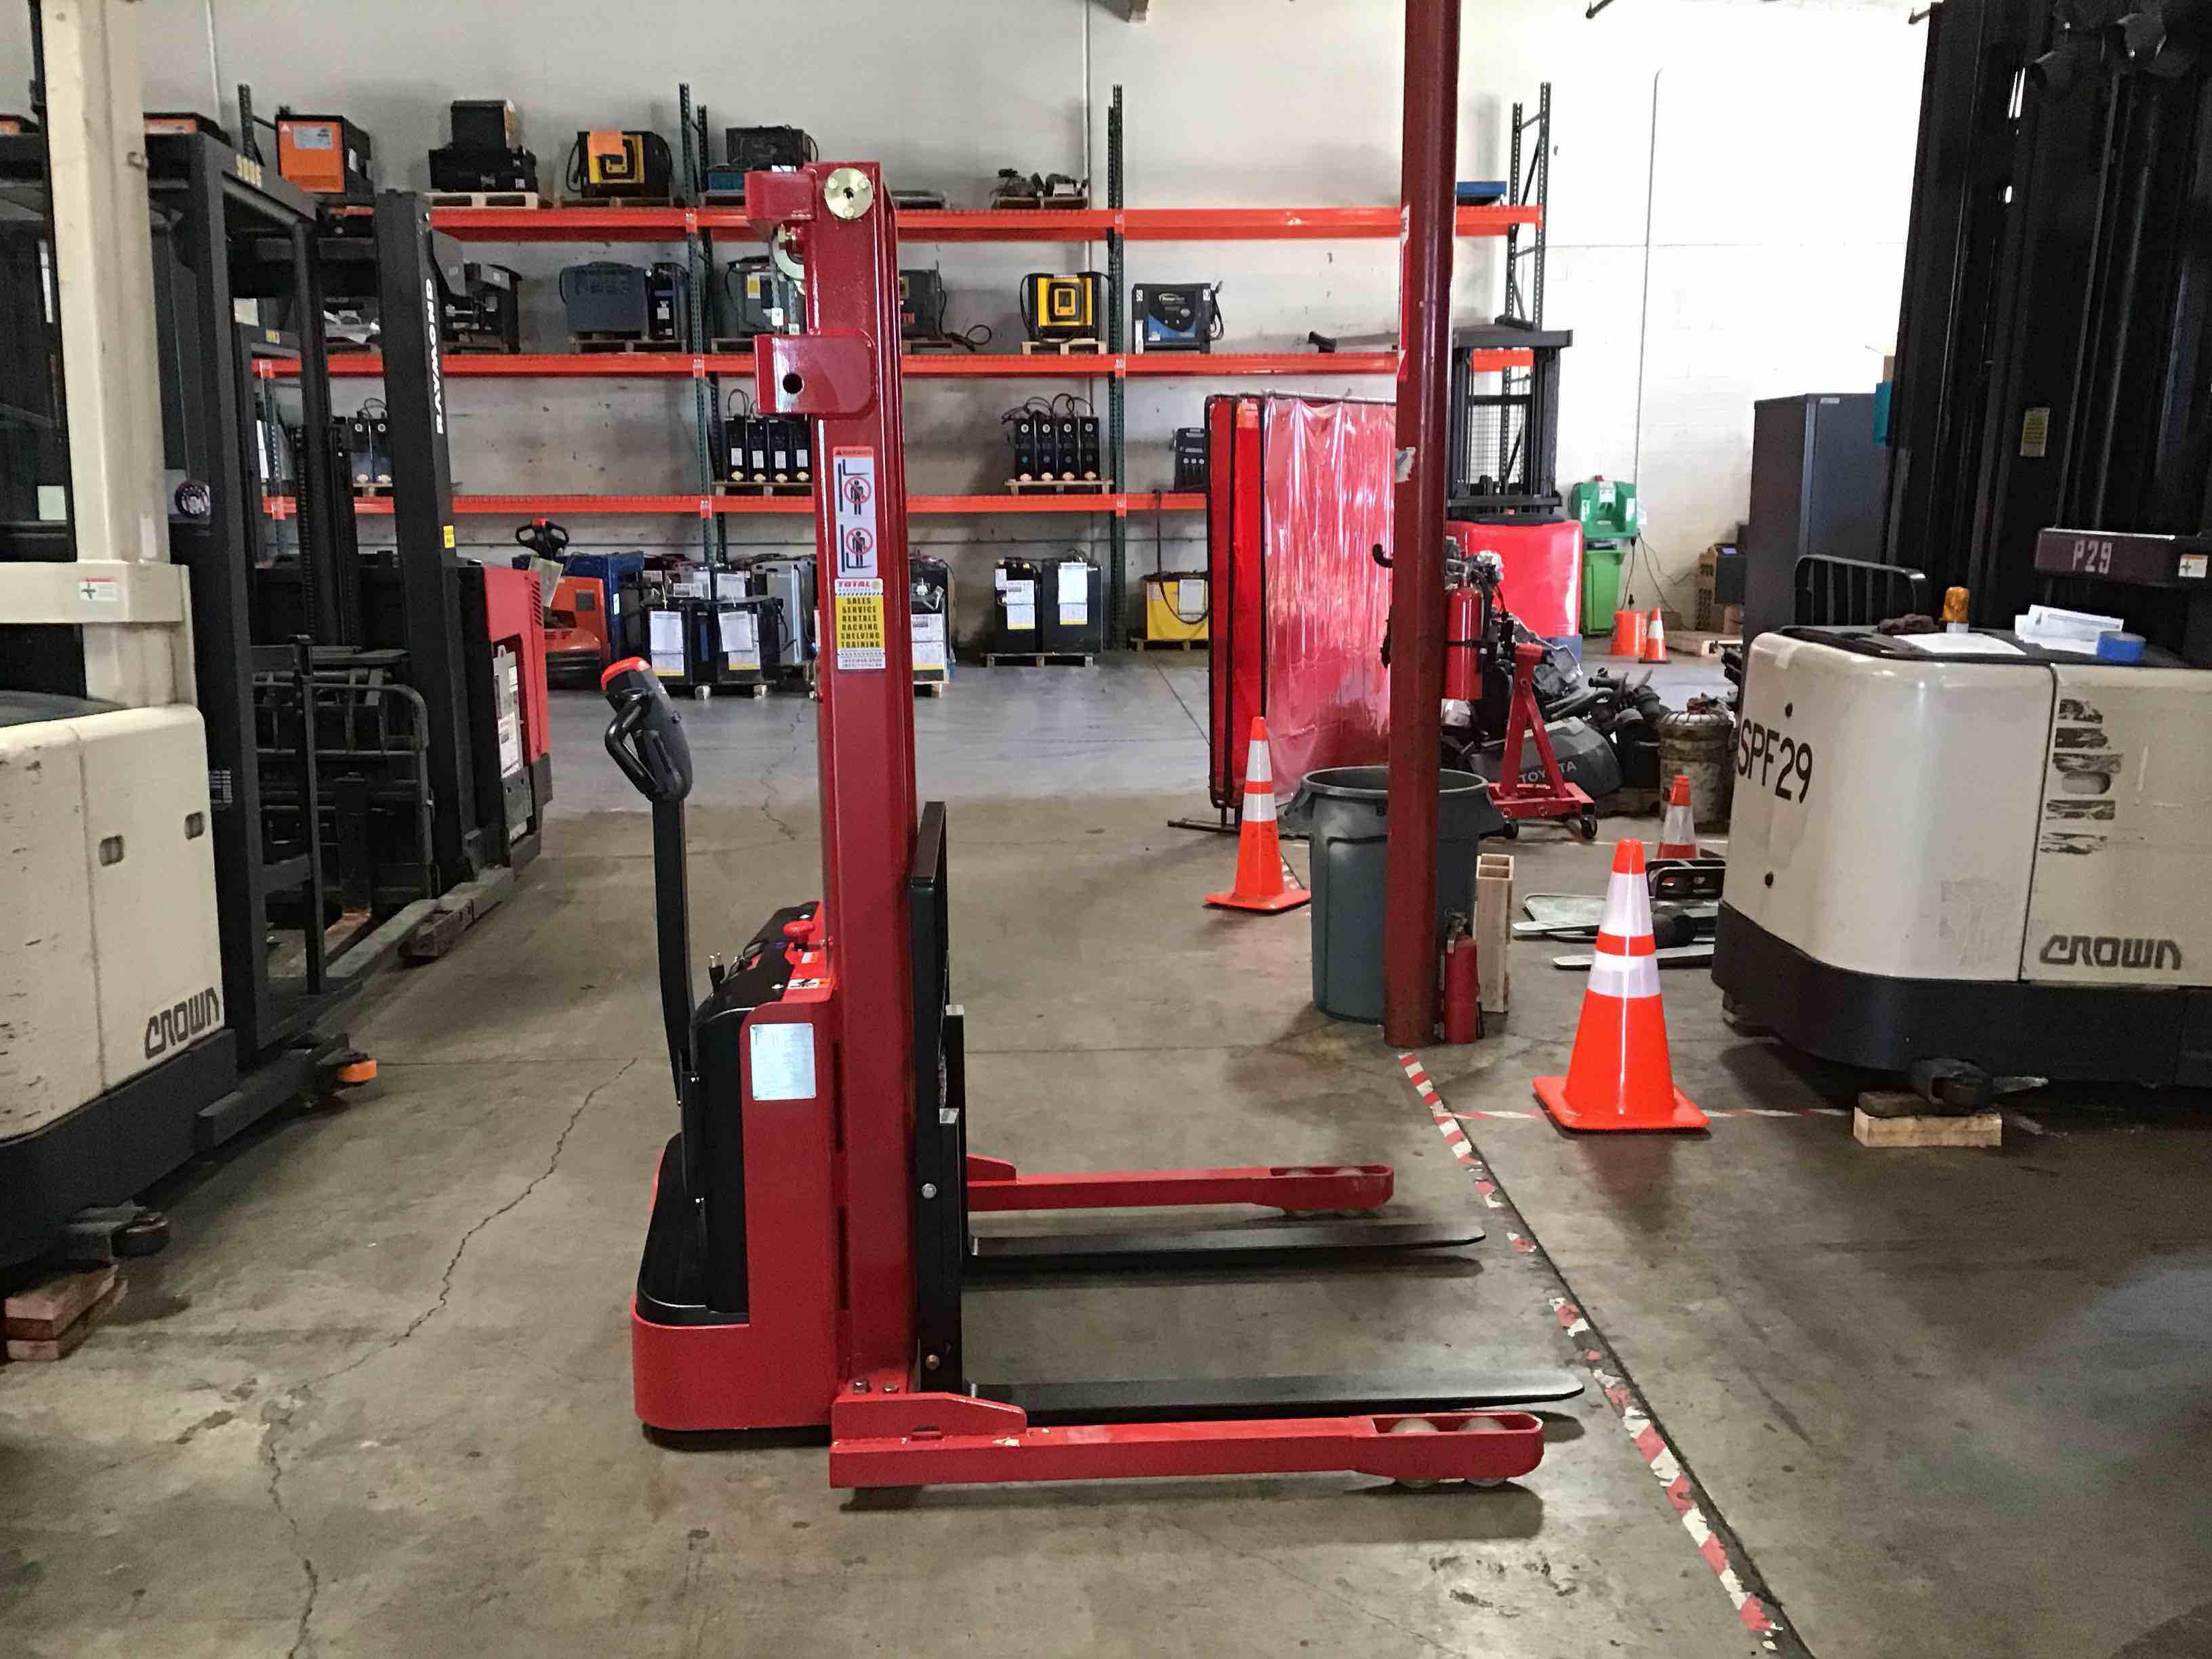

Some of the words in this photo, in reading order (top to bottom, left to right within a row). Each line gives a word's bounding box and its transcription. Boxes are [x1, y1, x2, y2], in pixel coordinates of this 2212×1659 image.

[426, 278, 443, 434] RAYMOND
[2072, 540, 2112, 574] P29
[841, 640, 880, 649] TRAINING
[1518, 761, 1577, 783] TOYTA
[2039, 935, 2182, 970] CROWN
[144, 987, 220, 1059] CROWN
